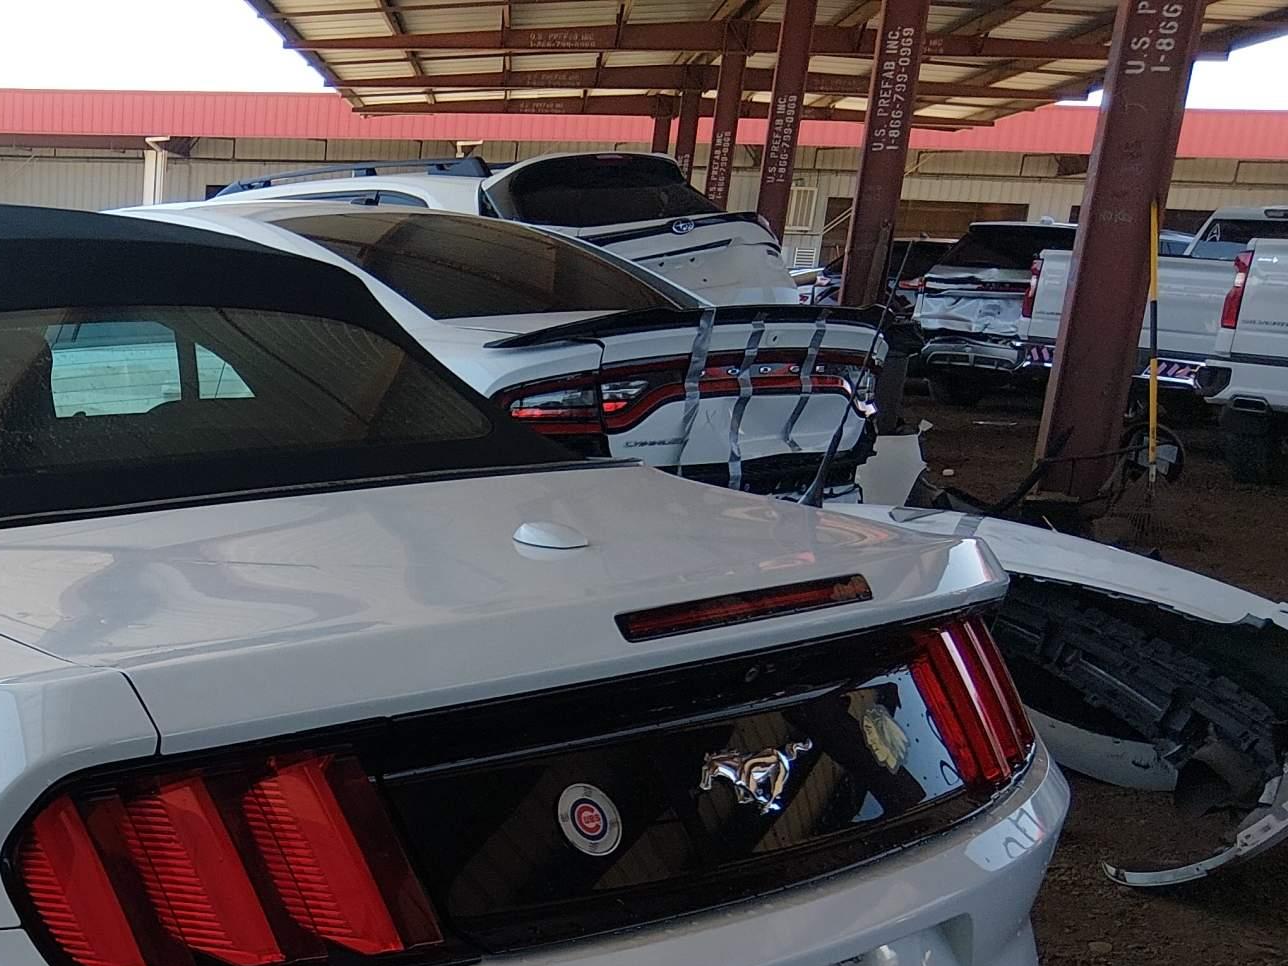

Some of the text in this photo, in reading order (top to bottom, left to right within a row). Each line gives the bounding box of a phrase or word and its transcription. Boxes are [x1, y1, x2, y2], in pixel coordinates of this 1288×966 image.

[872, 26, 901, 151] U.S. PREFAB INC.
[886, 28, 914, 149] 1-866-799-0969
[1125, 30, 1152, 74] U.S.
[766, 95, 788, 183] U.S. PREFAB INC.
